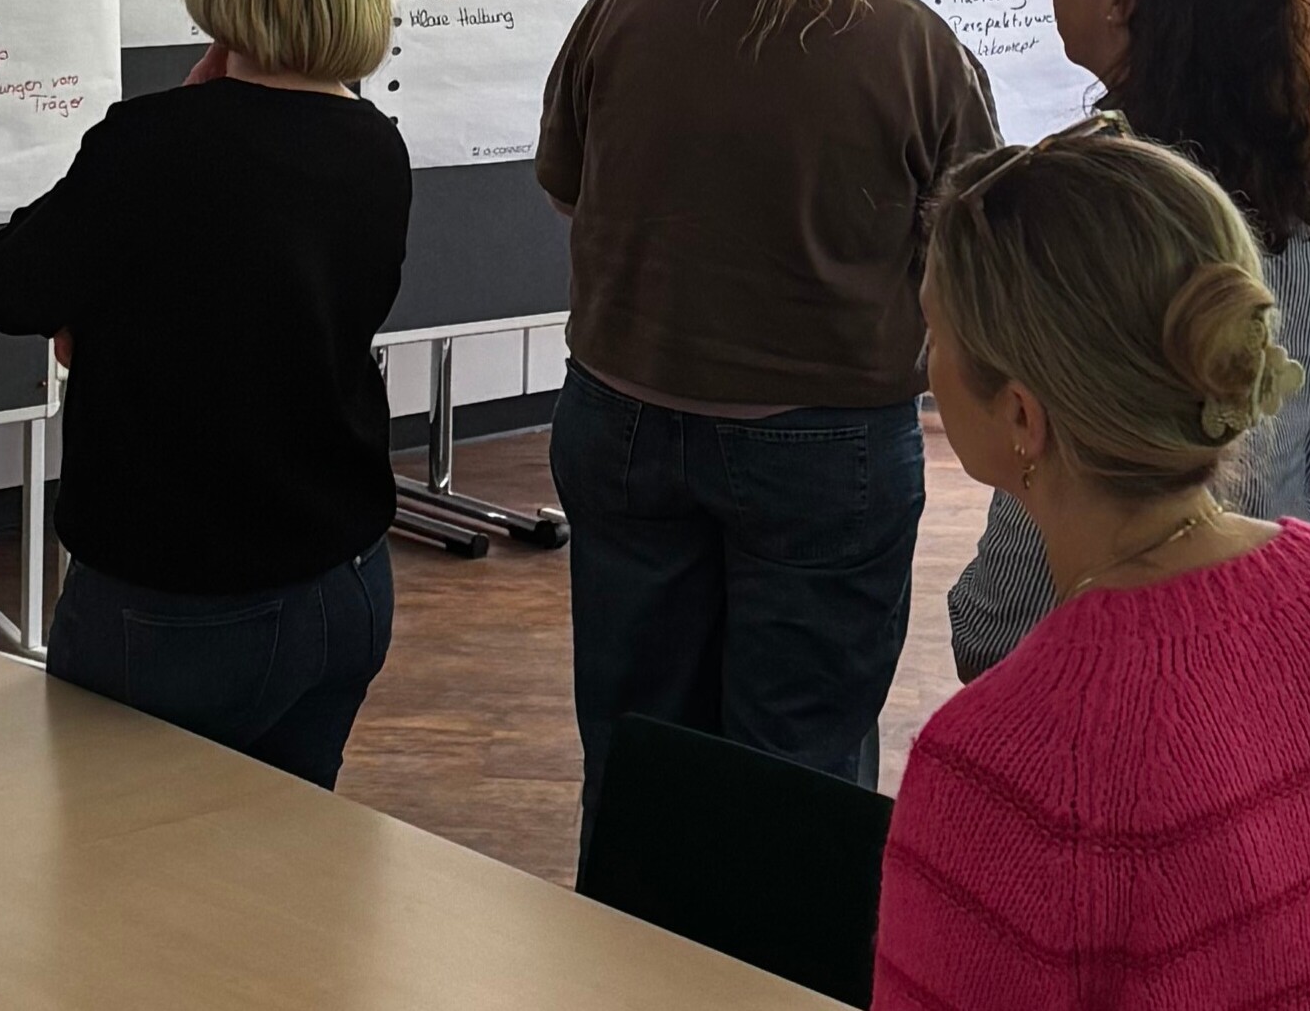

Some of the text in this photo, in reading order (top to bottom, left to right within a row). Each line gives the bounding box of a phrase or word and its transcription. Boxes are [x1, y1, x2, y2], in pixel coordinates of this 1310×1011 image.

[456, 6, 515, 30] Haltung
[51, 74, 80, 90] vom
[28, 93, 85, 118] Träger
